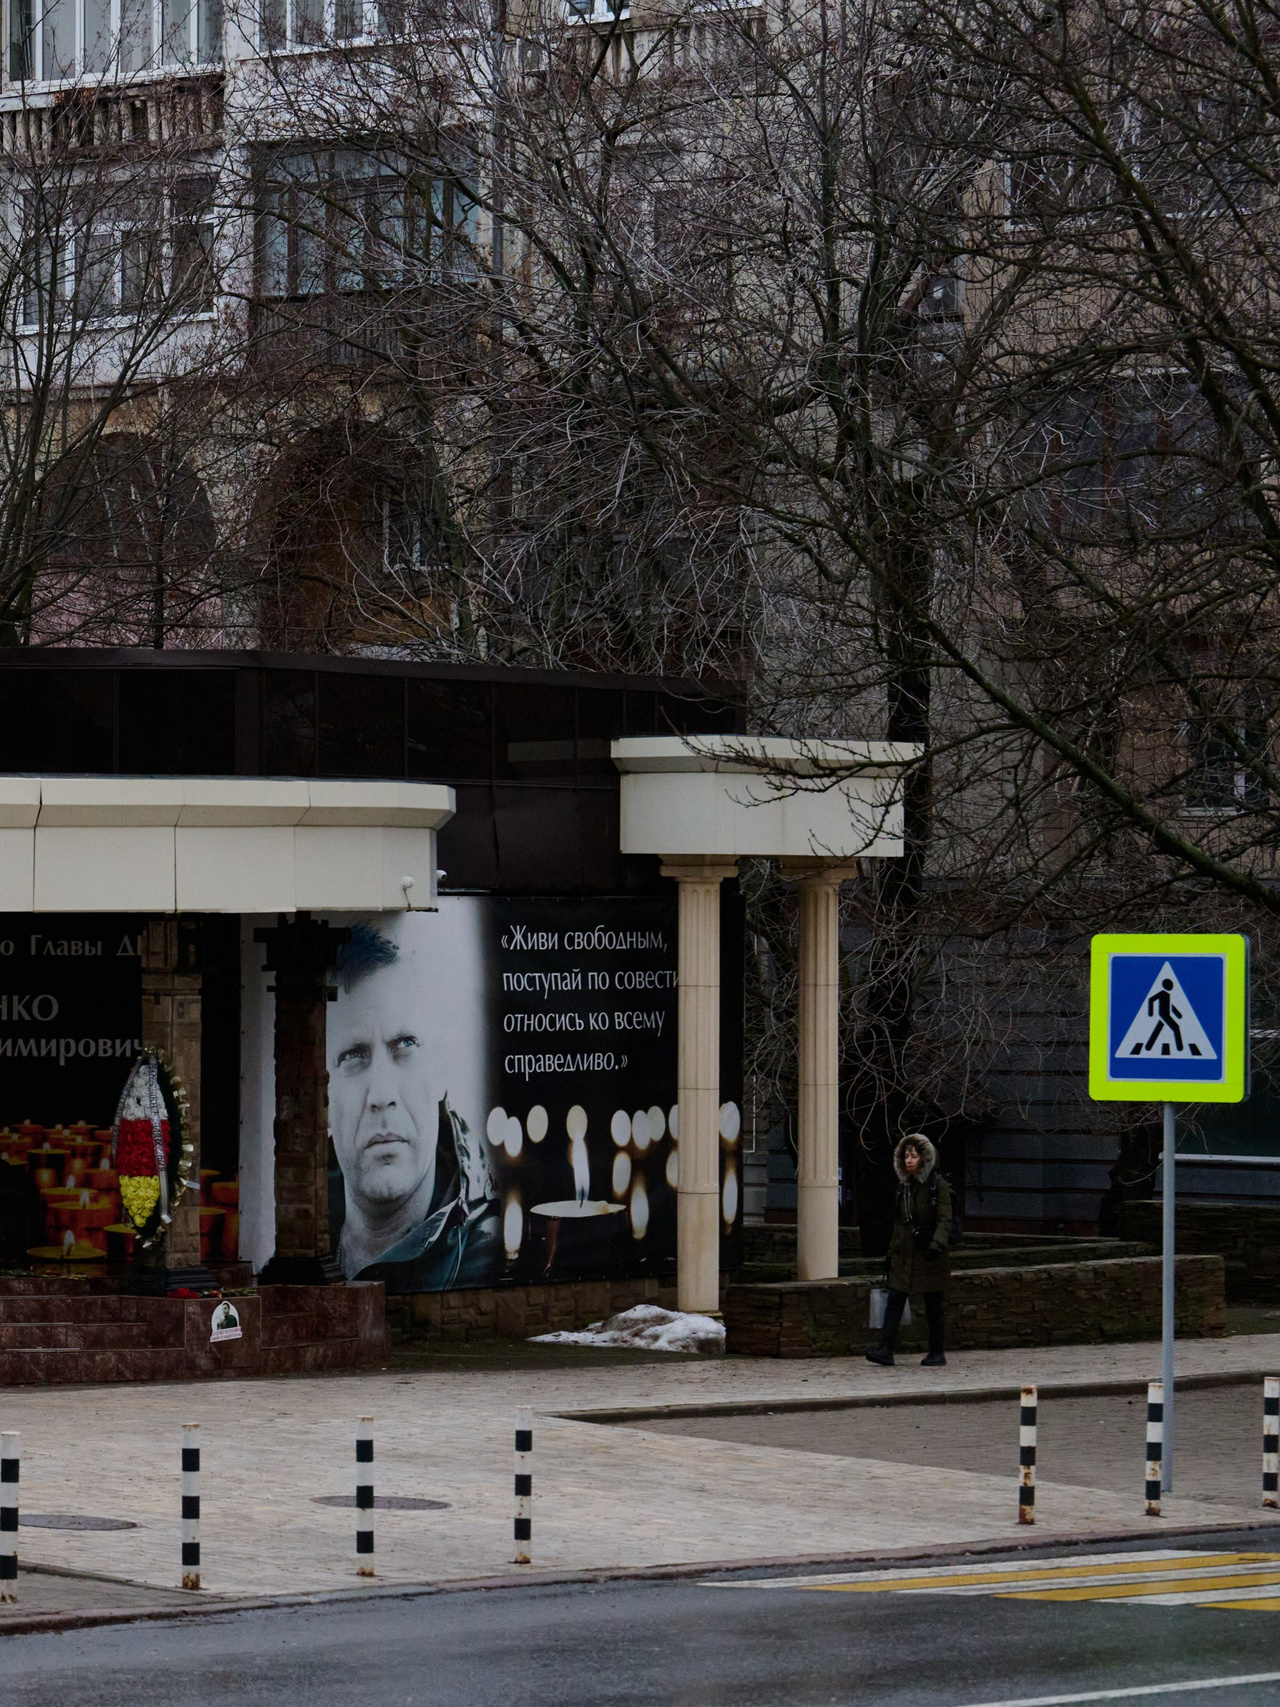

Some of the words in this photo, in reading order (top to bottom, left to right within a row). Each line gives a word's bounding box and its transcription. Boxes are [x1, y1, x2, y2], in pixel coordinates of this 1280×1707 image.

[30, 934, 103, 957] Главы
[501, 924, 559, 951] «Живи
[564, 924, 669, 954] свободным,
[503, 968, 582, 1000] поступай
[588, 971, 610, 991] по
[503, 1011, 584, 1033] относись
[589, 1012, 609, 1031] ко
[615, 1010, 666, 1037] всему
[504, 1052, 629, 1082] справедливо.»
